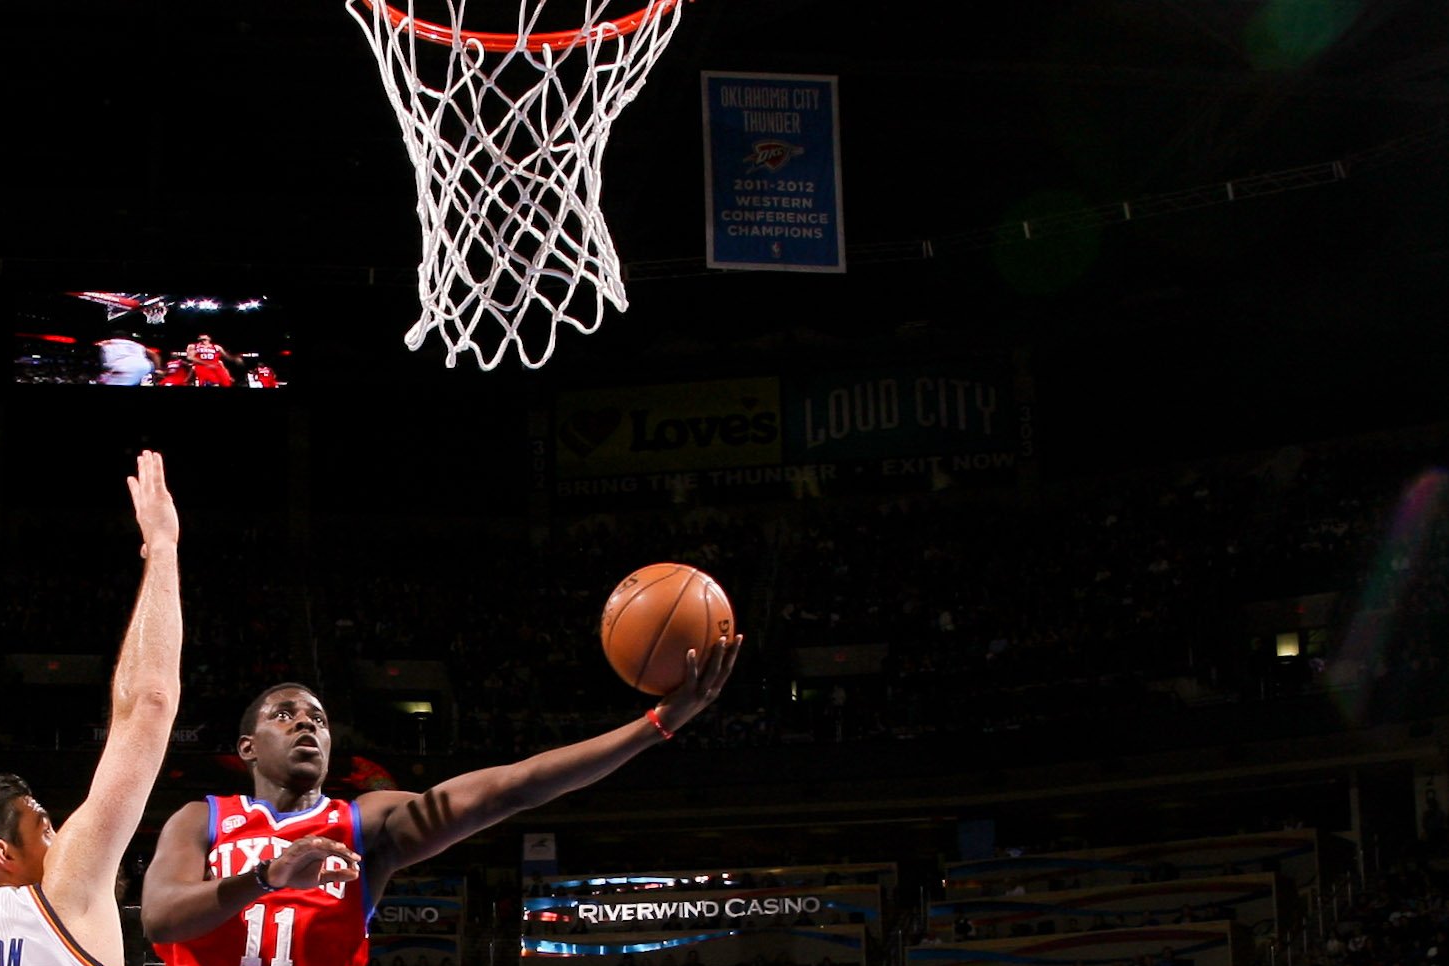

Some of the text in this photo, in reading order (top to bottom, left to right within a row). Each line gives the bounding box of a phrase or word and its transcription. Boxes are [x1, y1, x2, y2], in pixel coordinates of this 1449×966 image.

[721, 86, 821, 110] OKLAHOMA CITY
[743, 111, 801, 134] THUNDER
[733, 179, 815, 192] 2011-2012
[735, 196, 813, 208] WESTERN
[721, 211, 828, 224] CONFERENCE
[727, 225, 823, 239] CHAMPIONS
[804, 377, 997, 449] LOUD CITY
[557, 476, 638, 498] BRING
[953, 453, 1015, 471] NOW
[374, 906, 439, 923] ASINO
[578, 896, 820, 923] RIVERWIND CASINO
